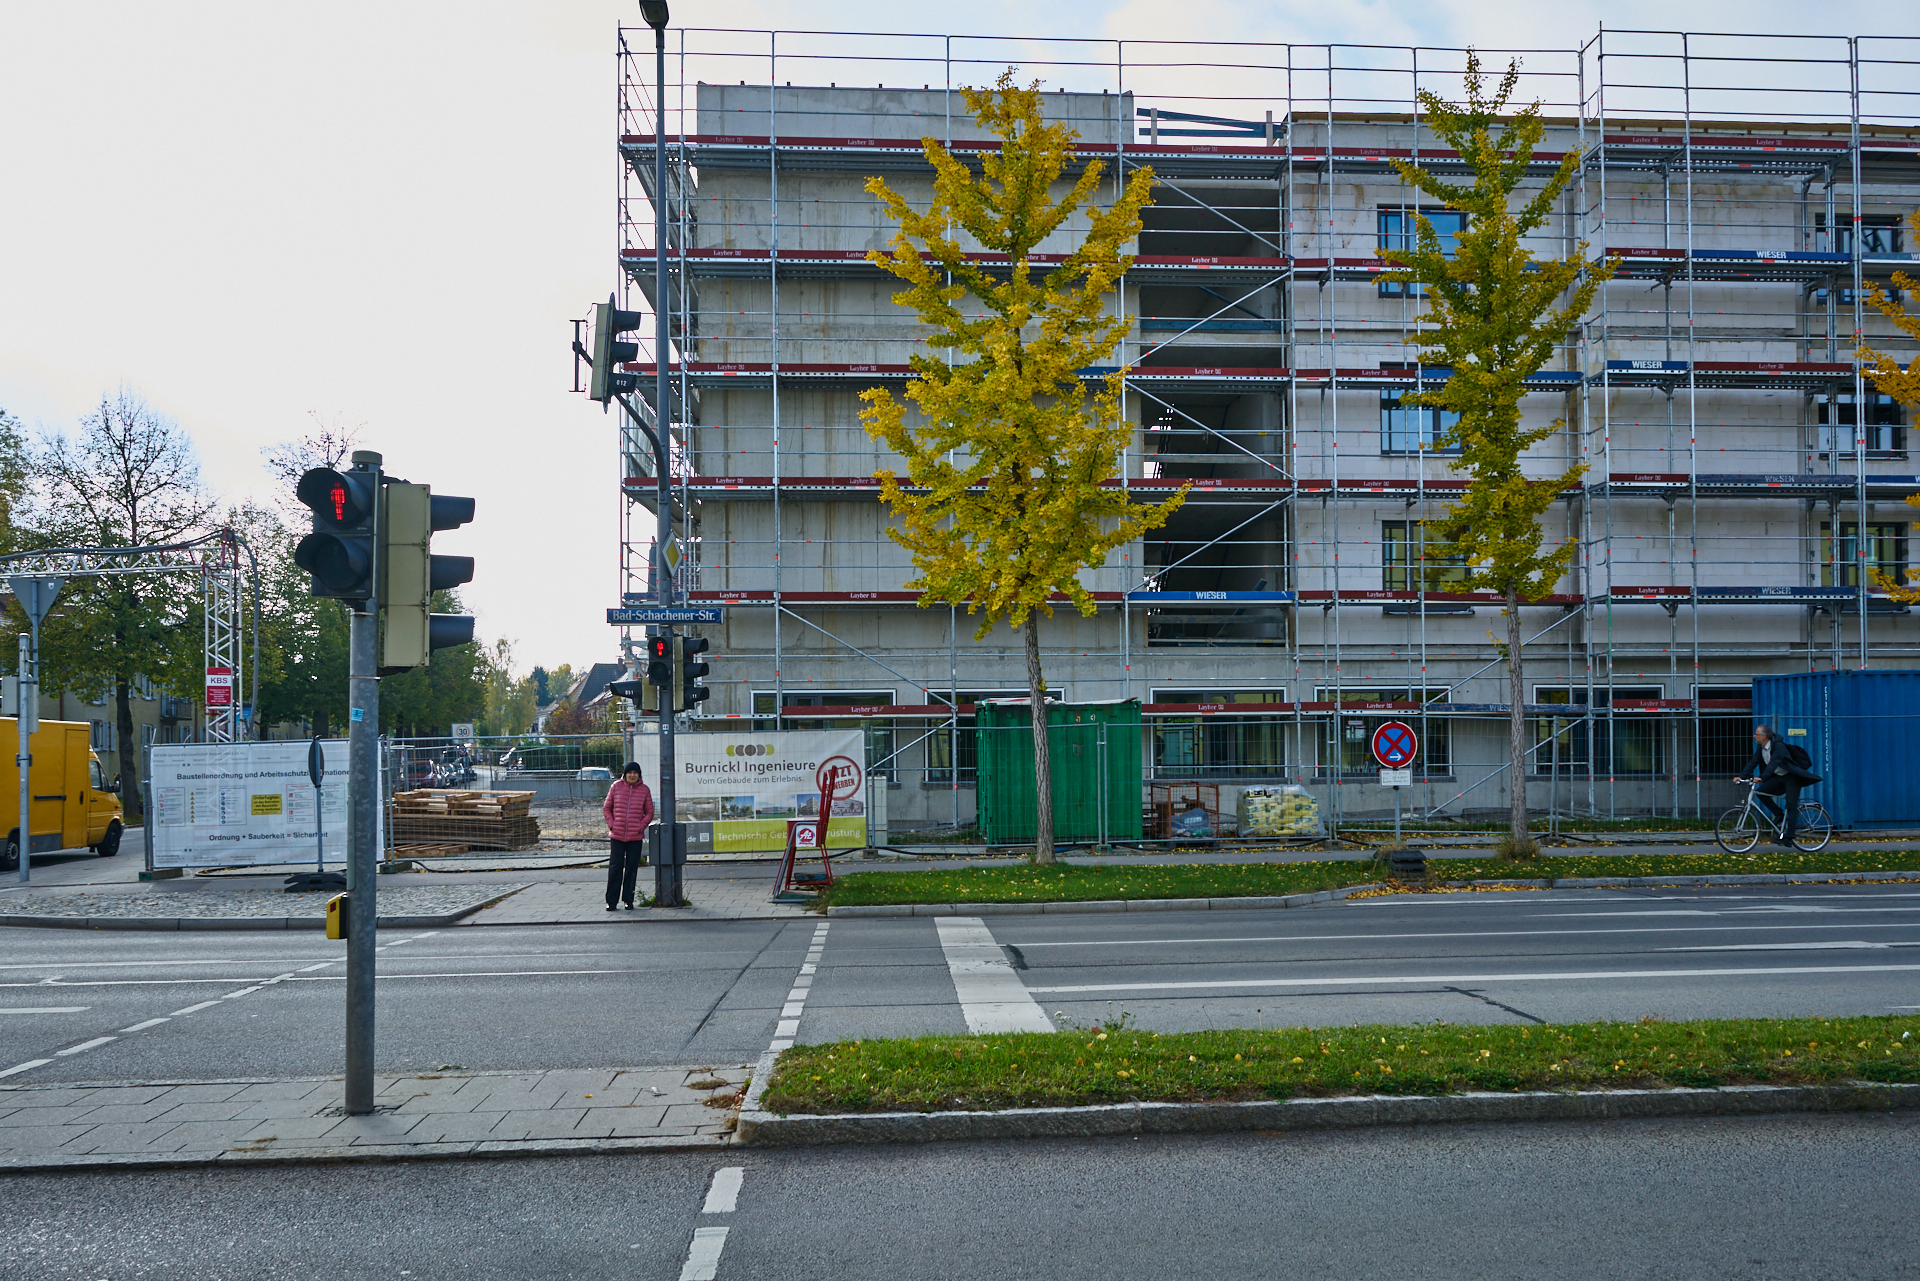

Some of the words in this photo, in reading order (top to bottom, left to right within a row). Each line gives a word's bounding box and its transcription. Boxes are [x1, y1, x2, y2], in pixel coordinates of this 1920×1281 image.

[715, 136, 735, 144] Layher
[846, 251, 865, 259] Layher
[1756, 250, 1787, 259] WIESER
[849, 364, 869, 372] Layher
[1631, 360, 1663, 369] WIESER
[1194, 368, 1214, 376] Layher
[1361, 369, 1381, 377] Layher
[715, 477, 736, 485] Layher
[849, 477, 869, 485] Layher
[1634, 474, 1654, 482] Layher
[1363, 480, 1382, 488] Layher
[1761, 586, 1791, 595] WIESER
[850, 592, 869, 600] Layher
[1195, 591, 1227, 600] WIESER
[612, 609, 715, 621] Bad-Schachener-Str.
[850, 706, 870, 714] Layher
[1198, 703, 1217, 711] Layher
[1366, 702, 1386, 710] Layher
[685, 761, 740, 773] Burnickl
[745, 760, 816, 775] Ingenieure
[176, 772, 243, 780] Baustellenordnung
[697, 777, 715, 785] Vom
[717, 776, 751, 784] Gebäude
[772, 775, 804, 783] Erlebnis.
[826, 778, 856, 792] WERBEN
[209, 834, 240, 842] Ordnung
[248, 832, 285, 840] Sauberkeit
[717, 831, 768, 842] Technische
